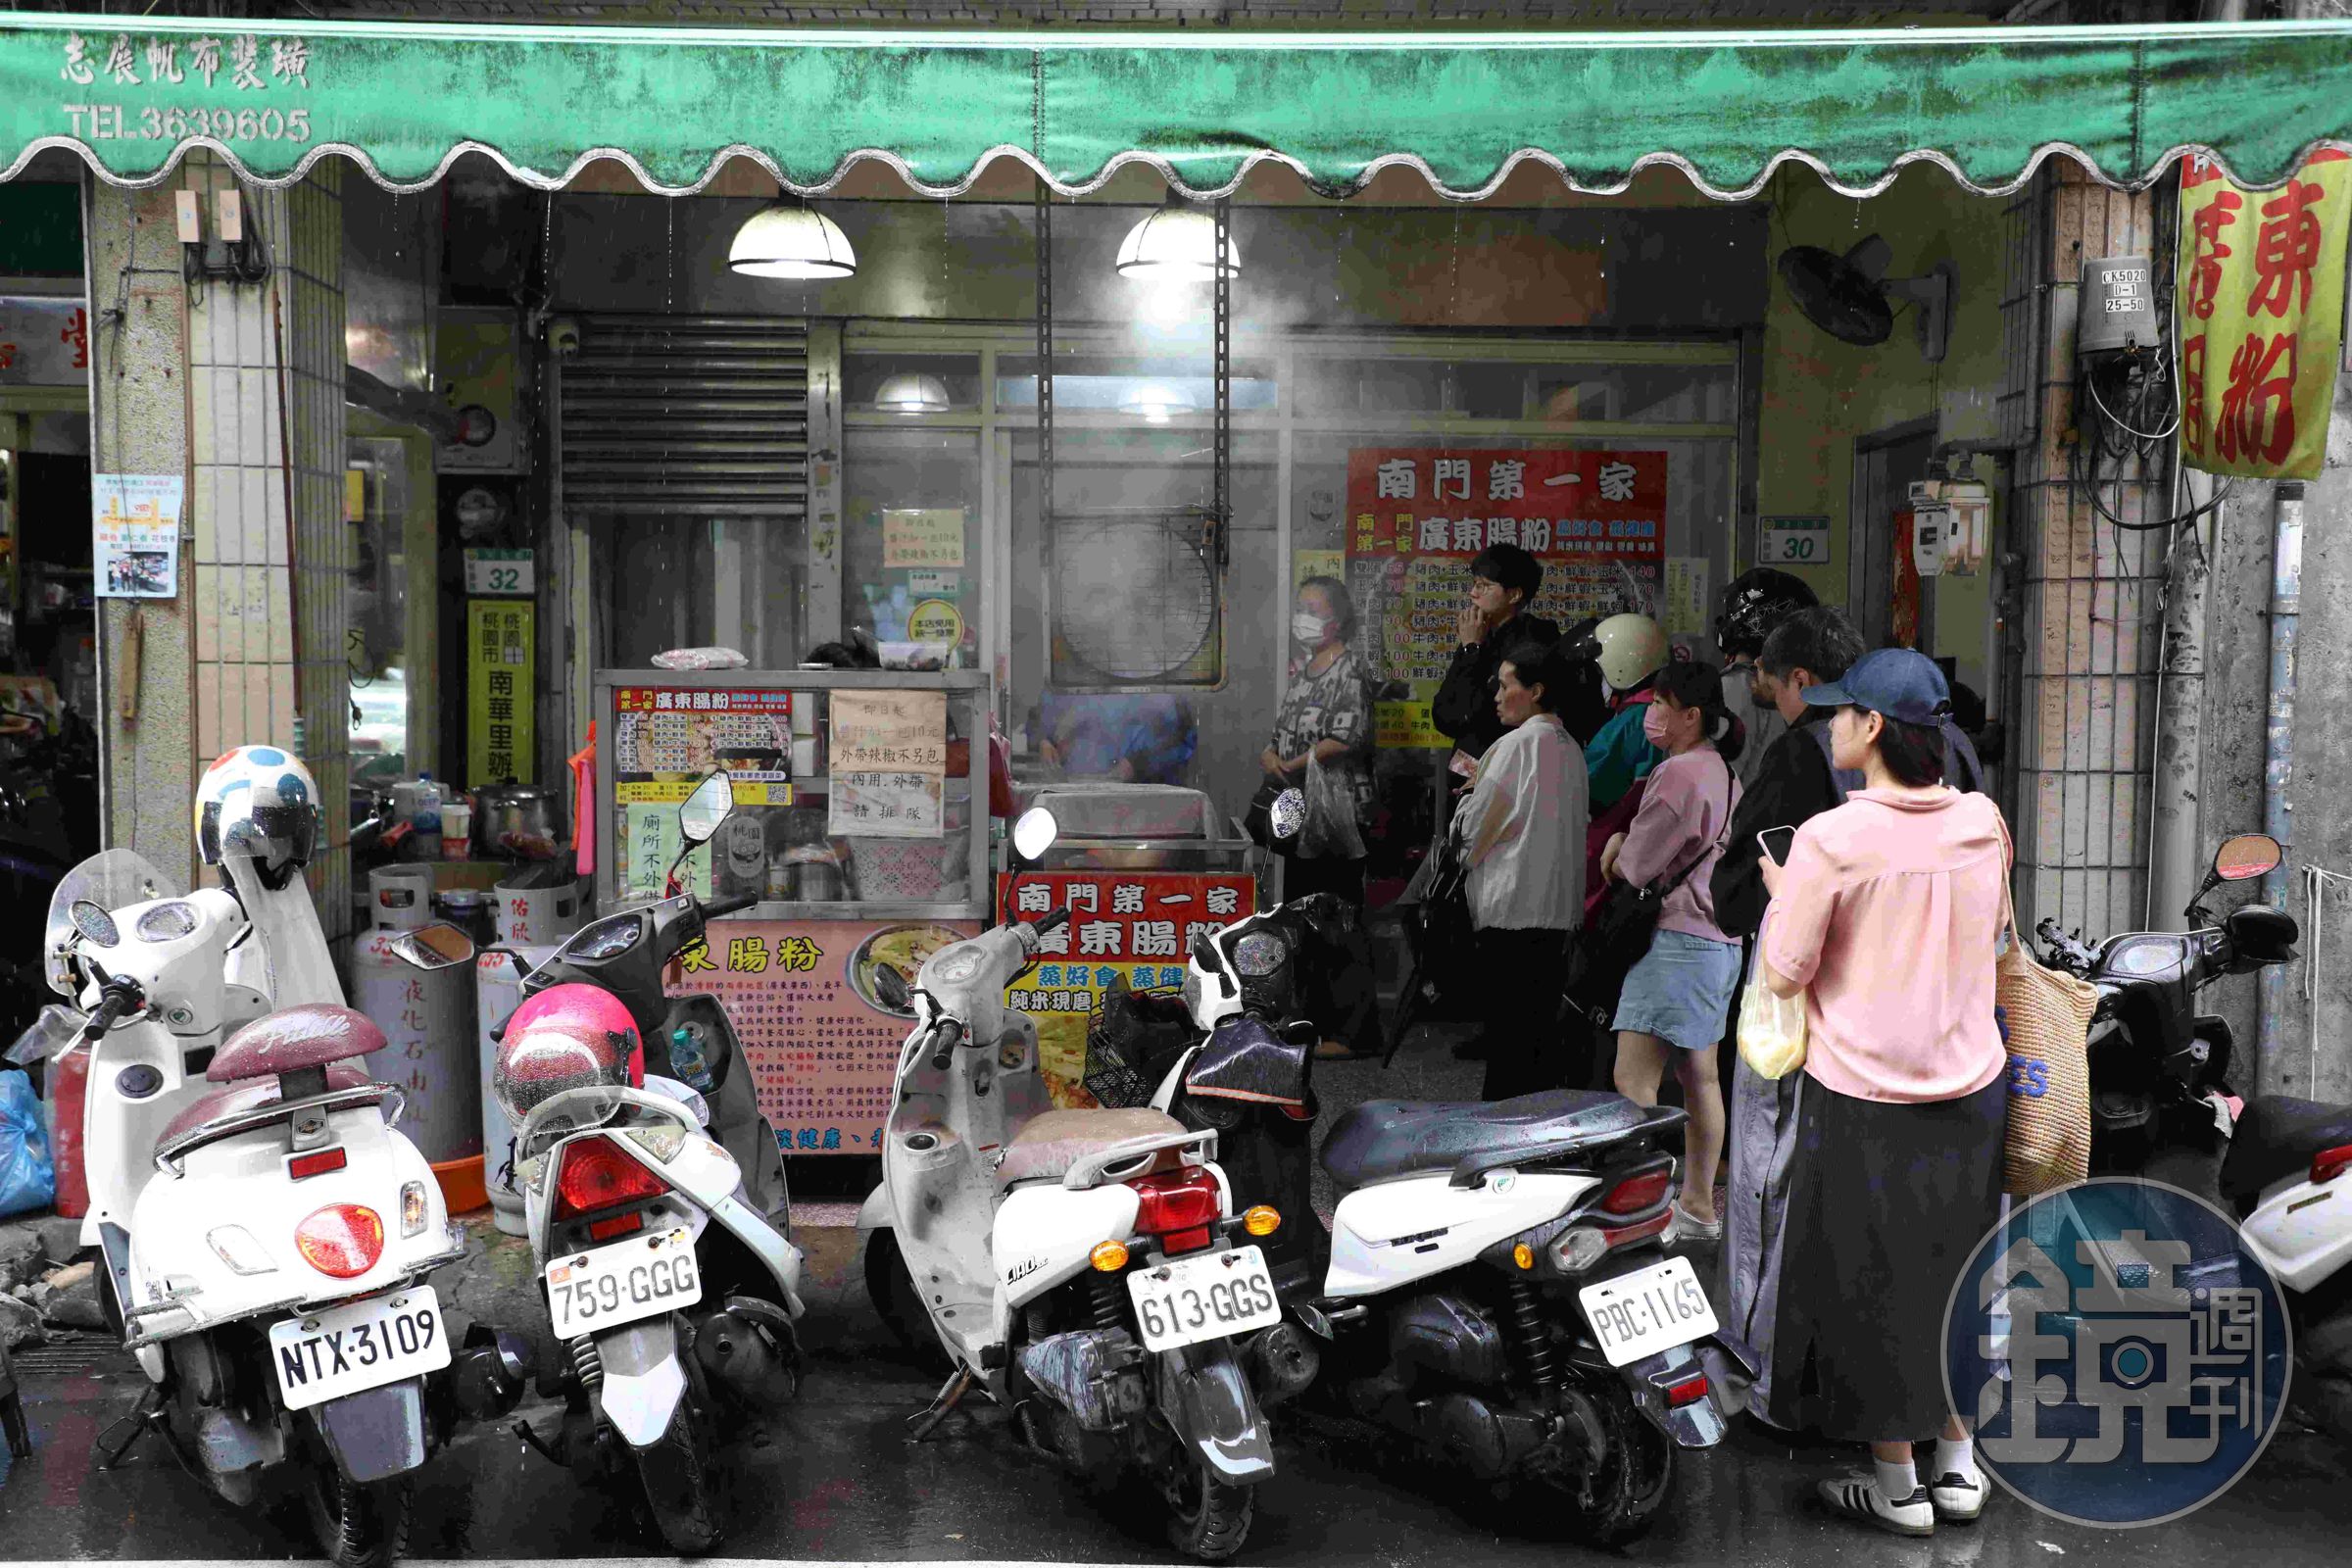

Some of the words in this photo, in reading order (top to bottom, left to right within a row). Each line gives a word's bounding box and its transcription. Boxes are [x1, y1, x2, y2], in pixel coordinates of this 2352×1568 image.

[2103, 270, 2146, 283] CK5020
[2115, 284, 2135, 296] D-1
[2107, 300, 2143, 312] 25-50
[1378, 458, 1638, 501] 南門第一家
[1418, 516, 1551, 553] 廣東腸粉
[1783, 537, 1814, 560] 30
[489, 567, 519, 590] 32
[656, 691, 729, 710] 廣東腸粉
[488, 670, 514, 782] 南華里辦
[841, 747, 940, 763] 外帶辣椒不另包
[1017, 883, 1241, 914] 南門第一家
[1009, 989, 1093, 1012] 純米現磨
